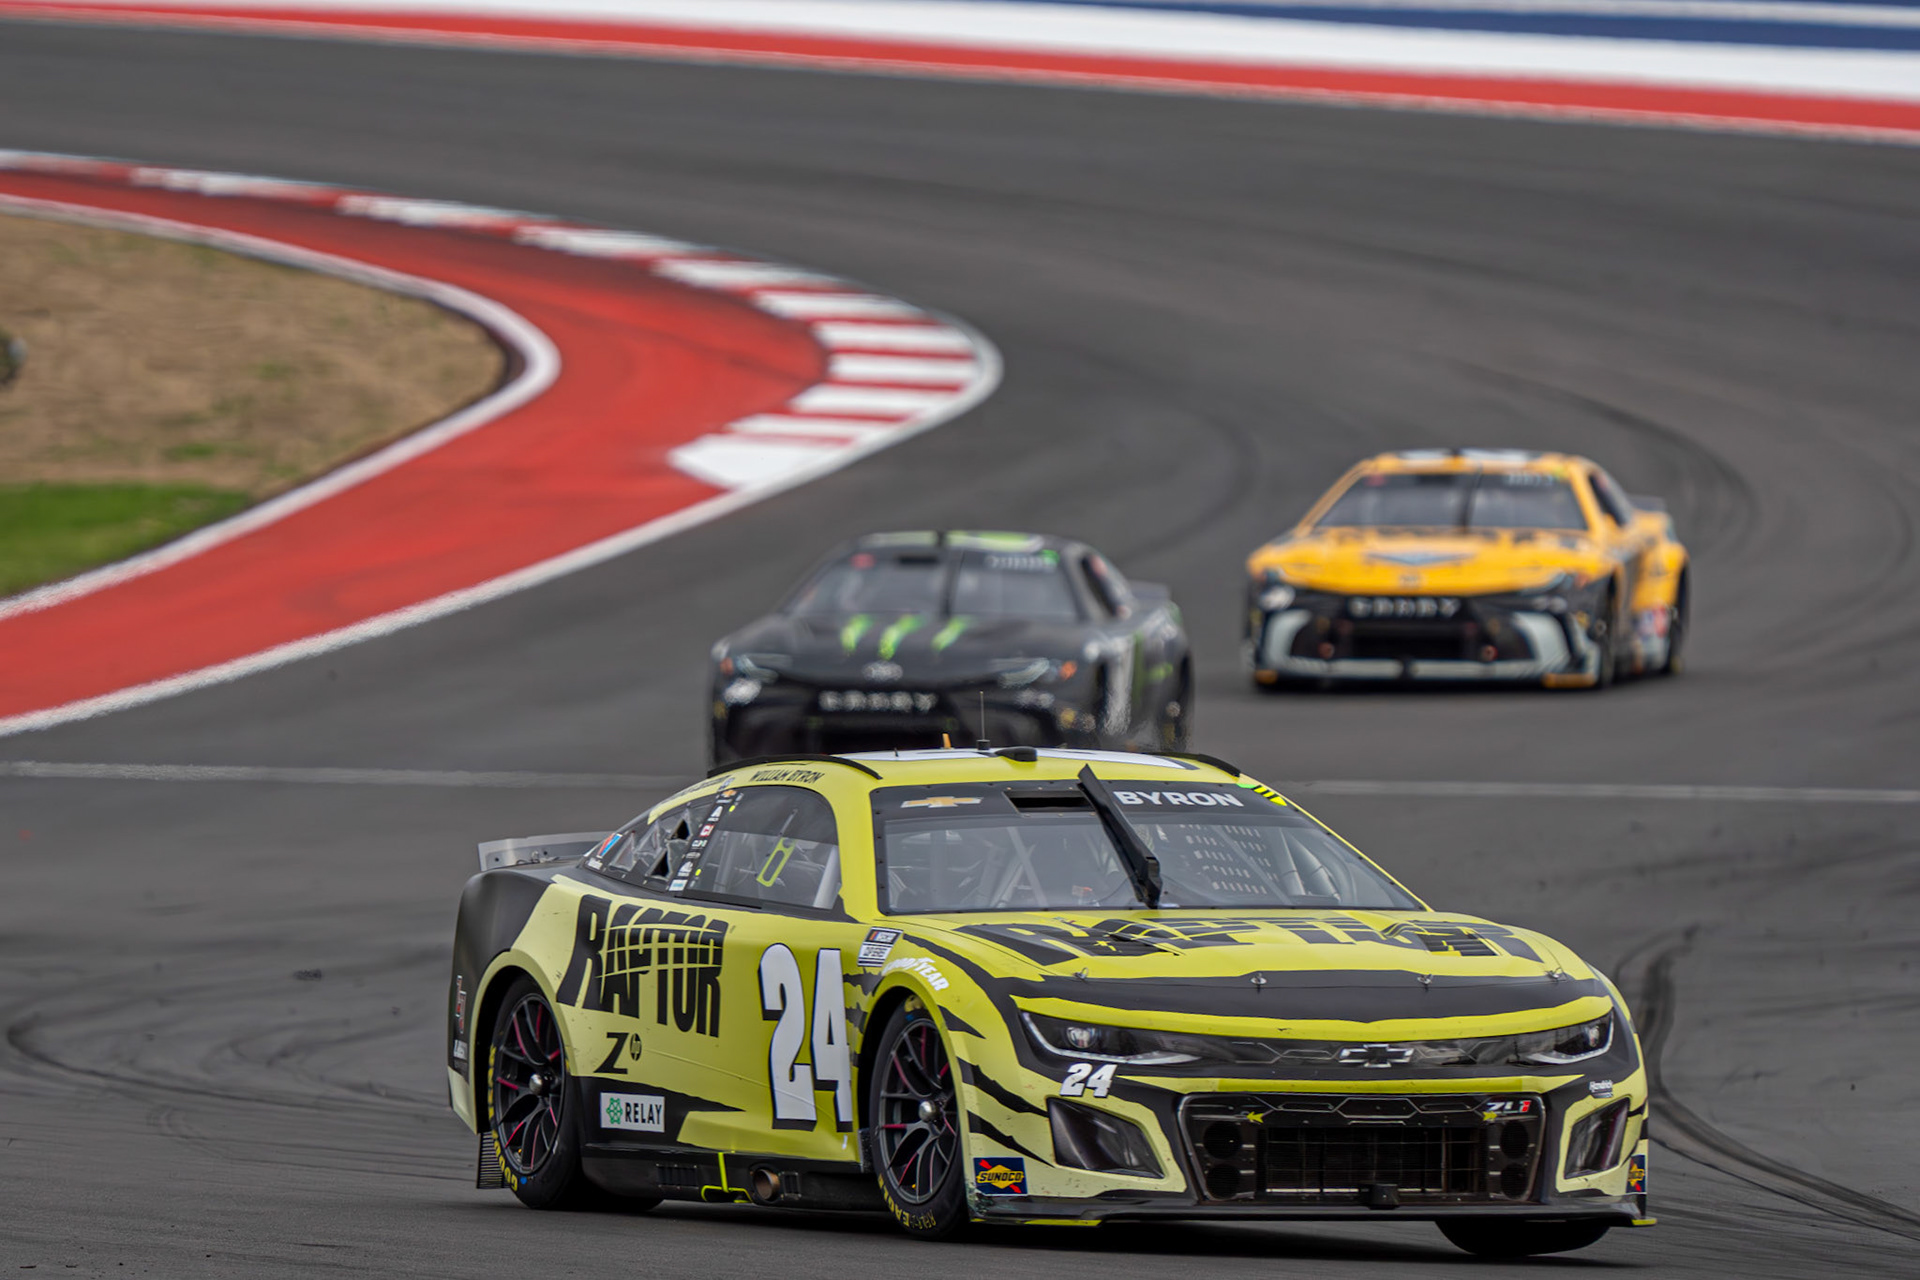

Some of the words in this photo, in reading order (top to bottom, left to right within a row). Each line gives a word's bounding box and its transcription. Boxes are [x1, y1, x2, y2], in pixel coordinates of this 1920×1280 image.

[749, 769, 790, 782] WILLIAM
[1113, 790, 1244, 807] BYRON
[556, 894, 729, 1038] RAPTOR
[759, 943, 854, 1133] 24
[1060, 1063, 1118, 1098] 24
[625, 1102, 662, 1125] RELAY
[1486, 1100, 1532, 1113] ZL1
[979, 1172, 1023, 1182] SUNOCO
